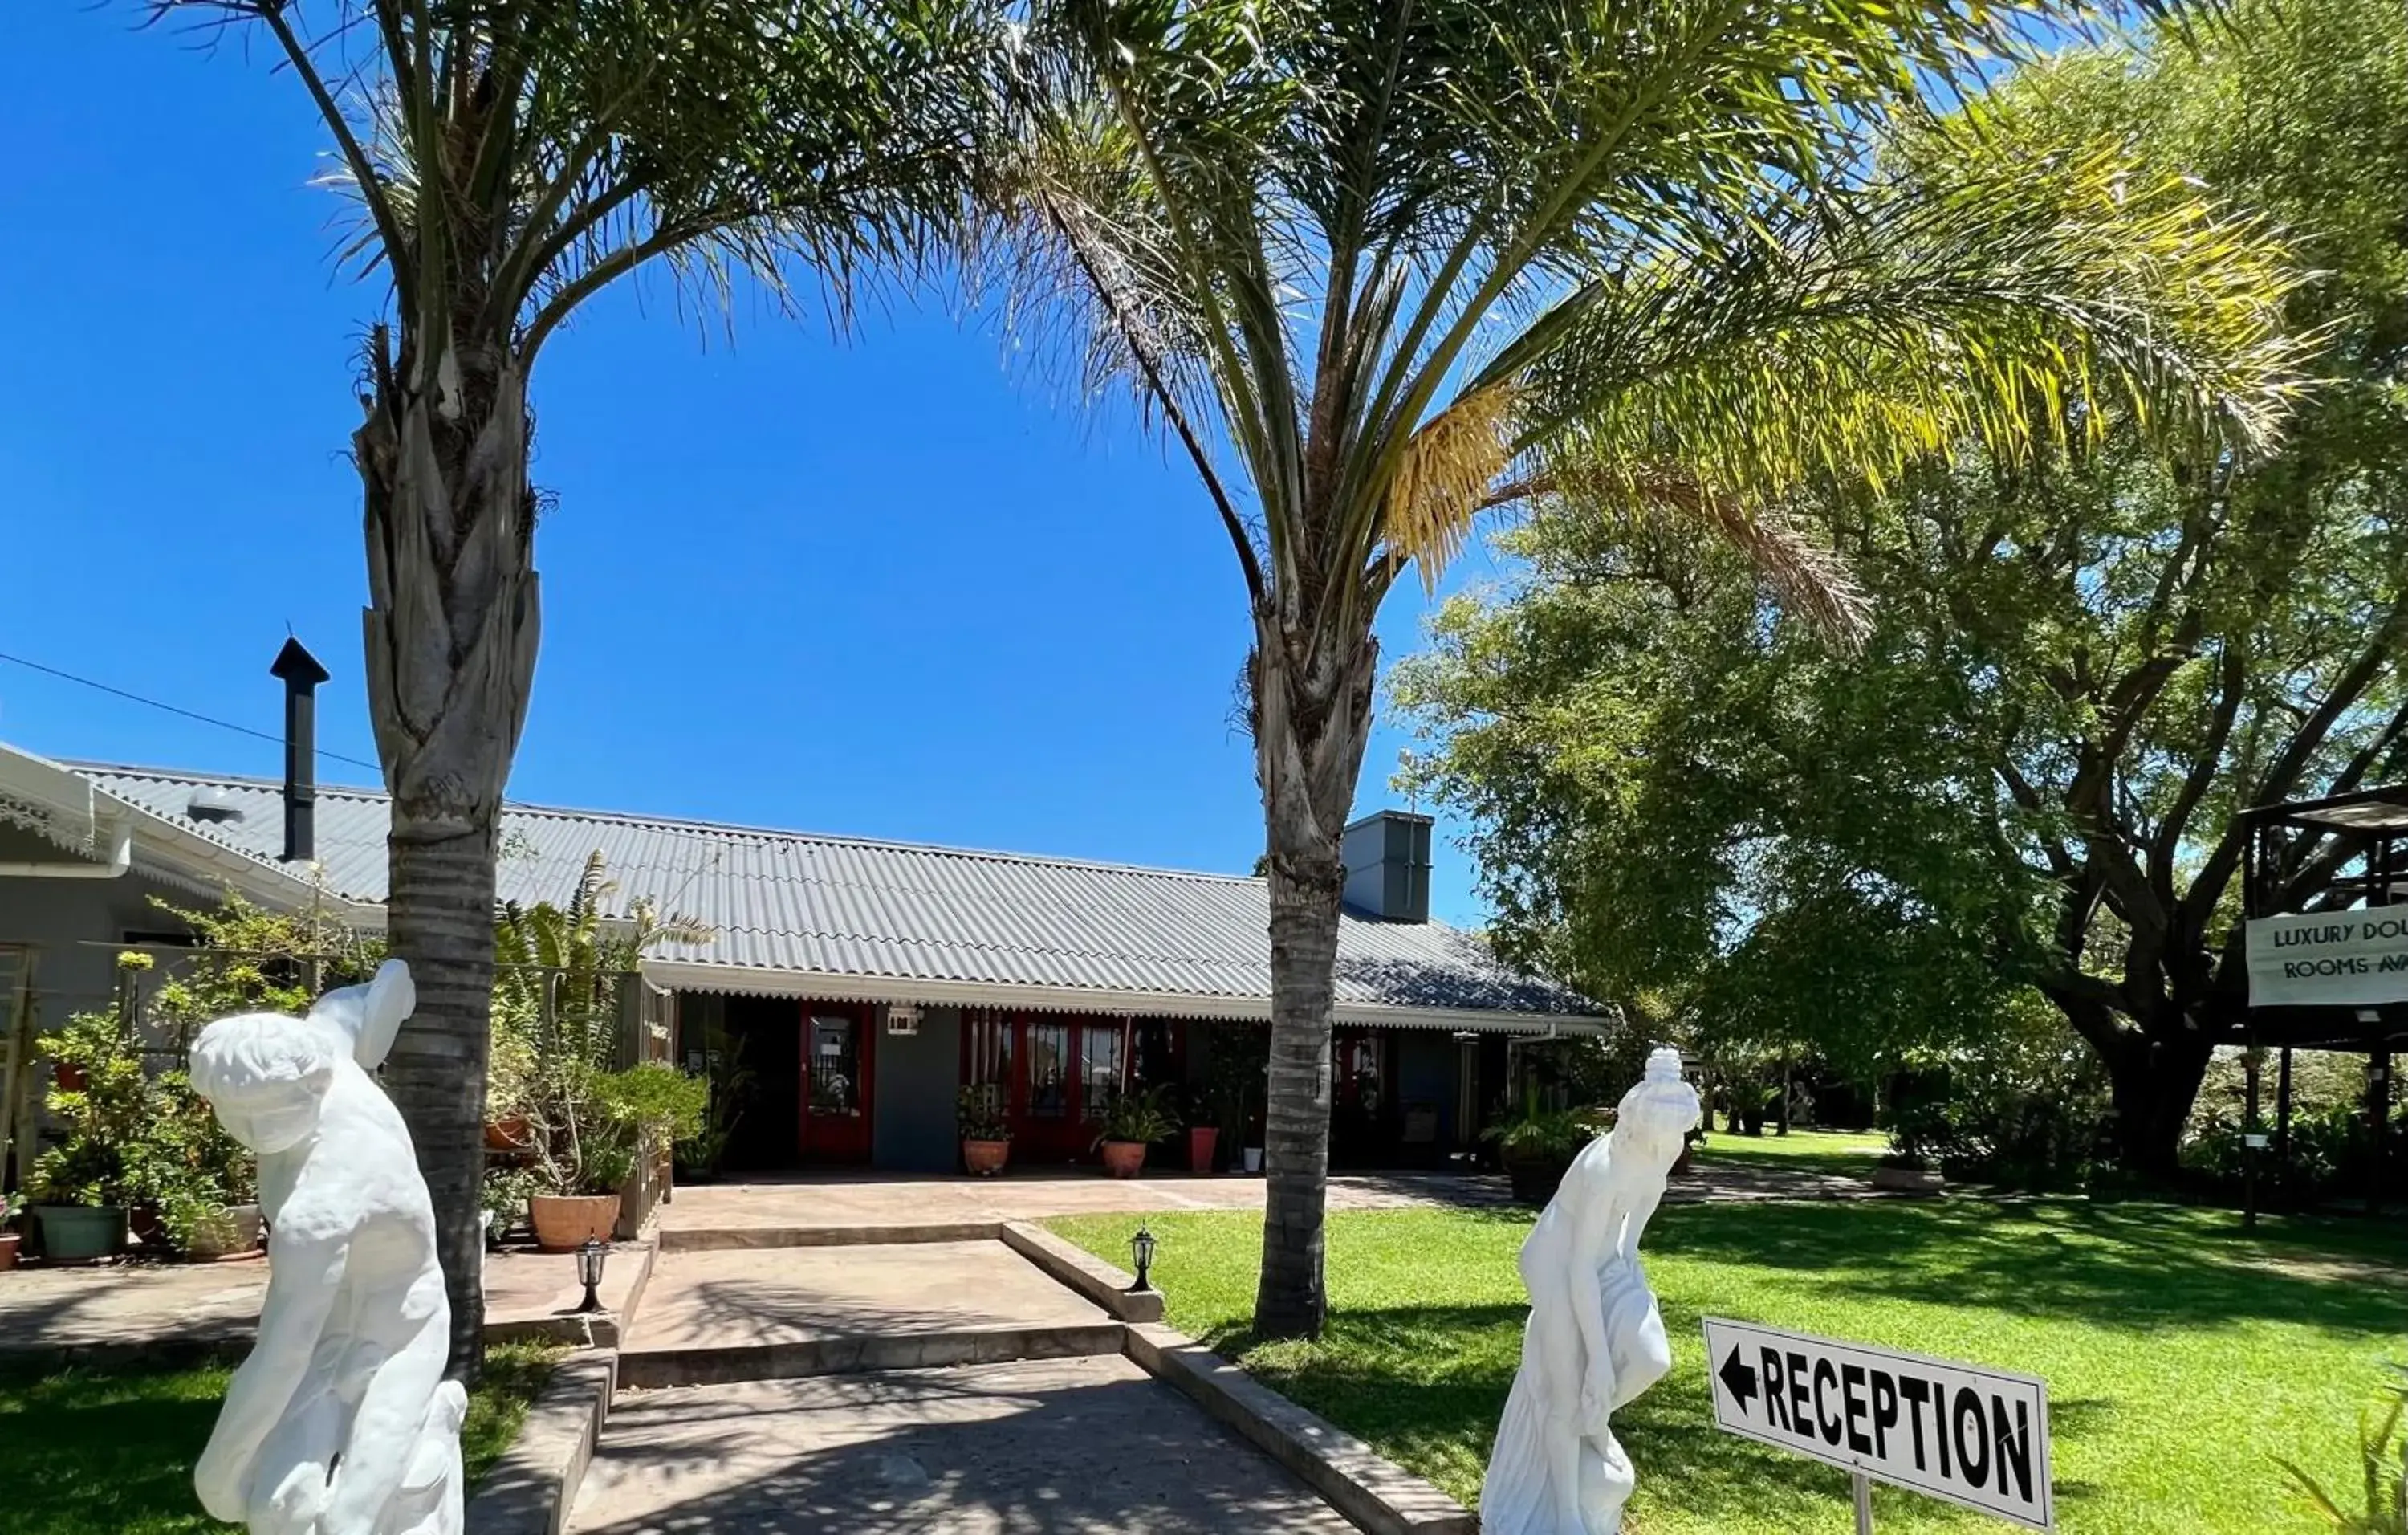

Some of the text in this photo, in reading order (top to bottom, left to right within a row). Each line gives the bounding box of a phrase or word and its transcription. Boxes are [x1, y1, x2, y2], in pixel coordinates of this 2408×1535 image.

[2274, 924, 2355, 947] LUXURY
[2284, 958, 2369, 978] ROOMS
[1759, 1346, 2033, 1504] RECEPTION
